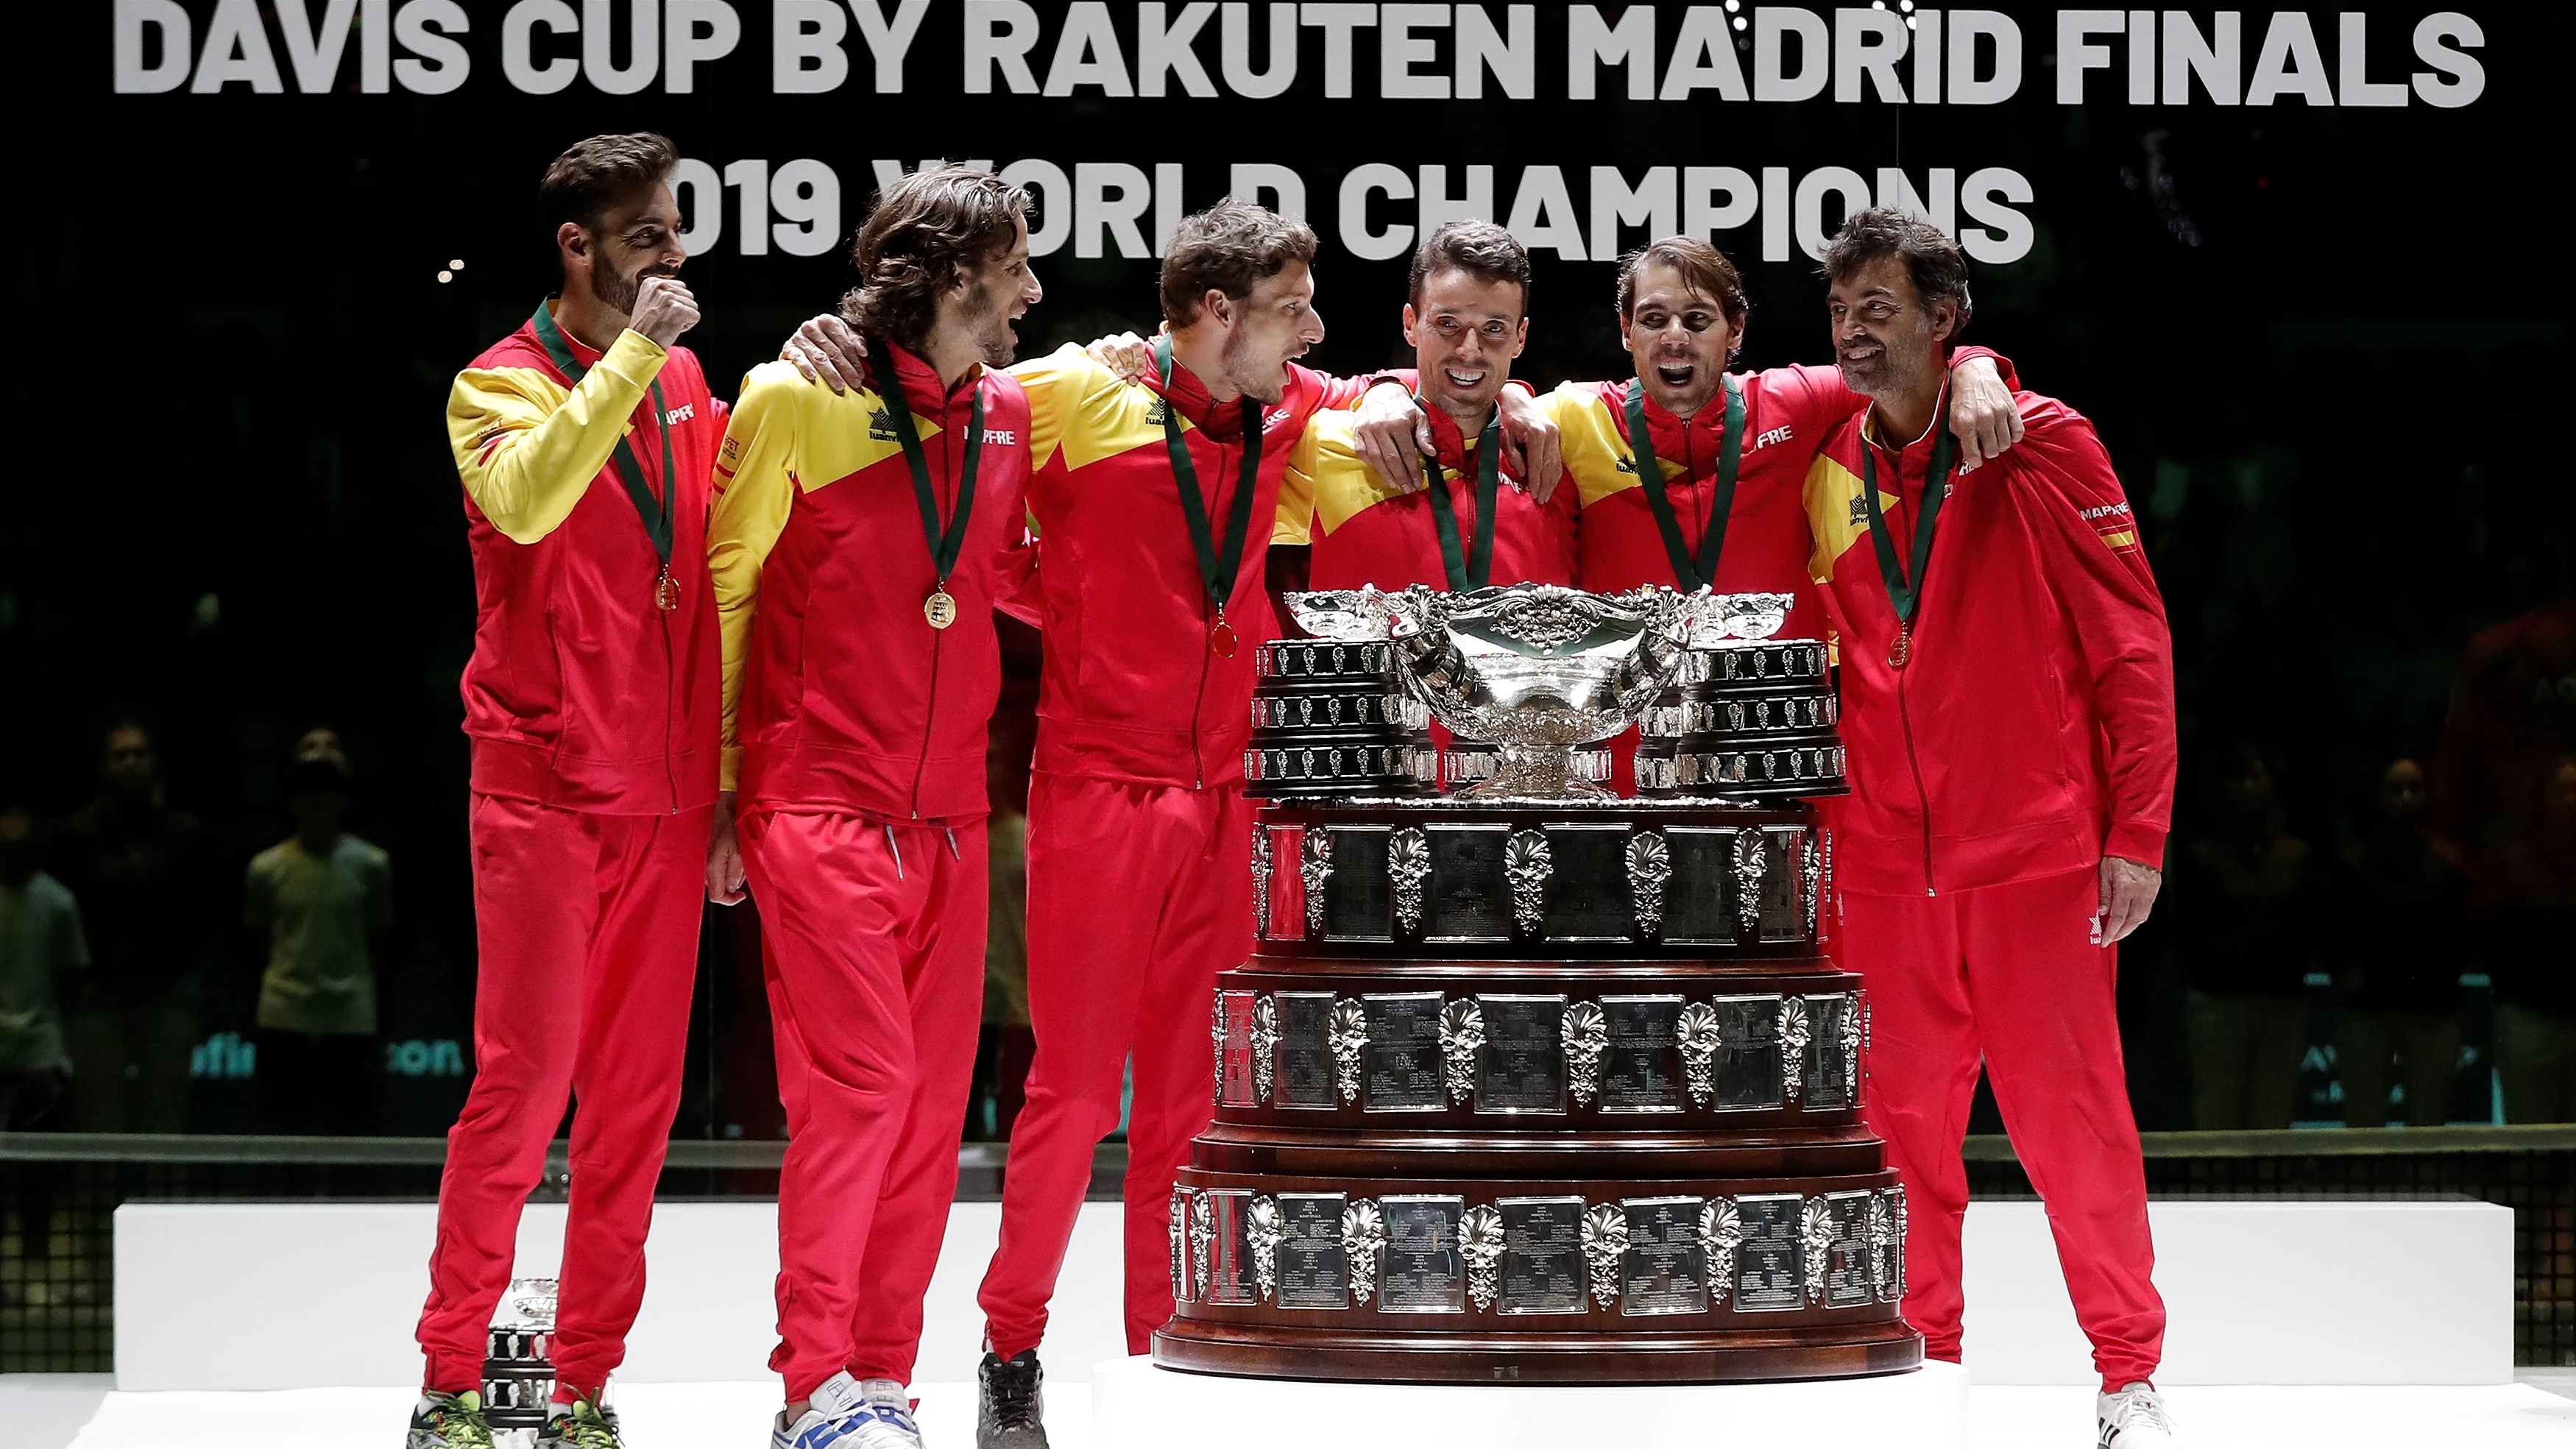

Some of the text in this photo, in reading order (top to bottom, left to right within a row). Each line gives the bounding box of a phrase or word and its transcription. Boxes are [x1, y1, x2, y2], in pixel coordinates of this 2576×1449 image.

[114, 0, 2485, 108] DAVIS CUP BY RAKUTEN MADRID FINALS
[675, 157, 841, 258] 019
[1338, 163, 2034, 265] CHAMPIONS
